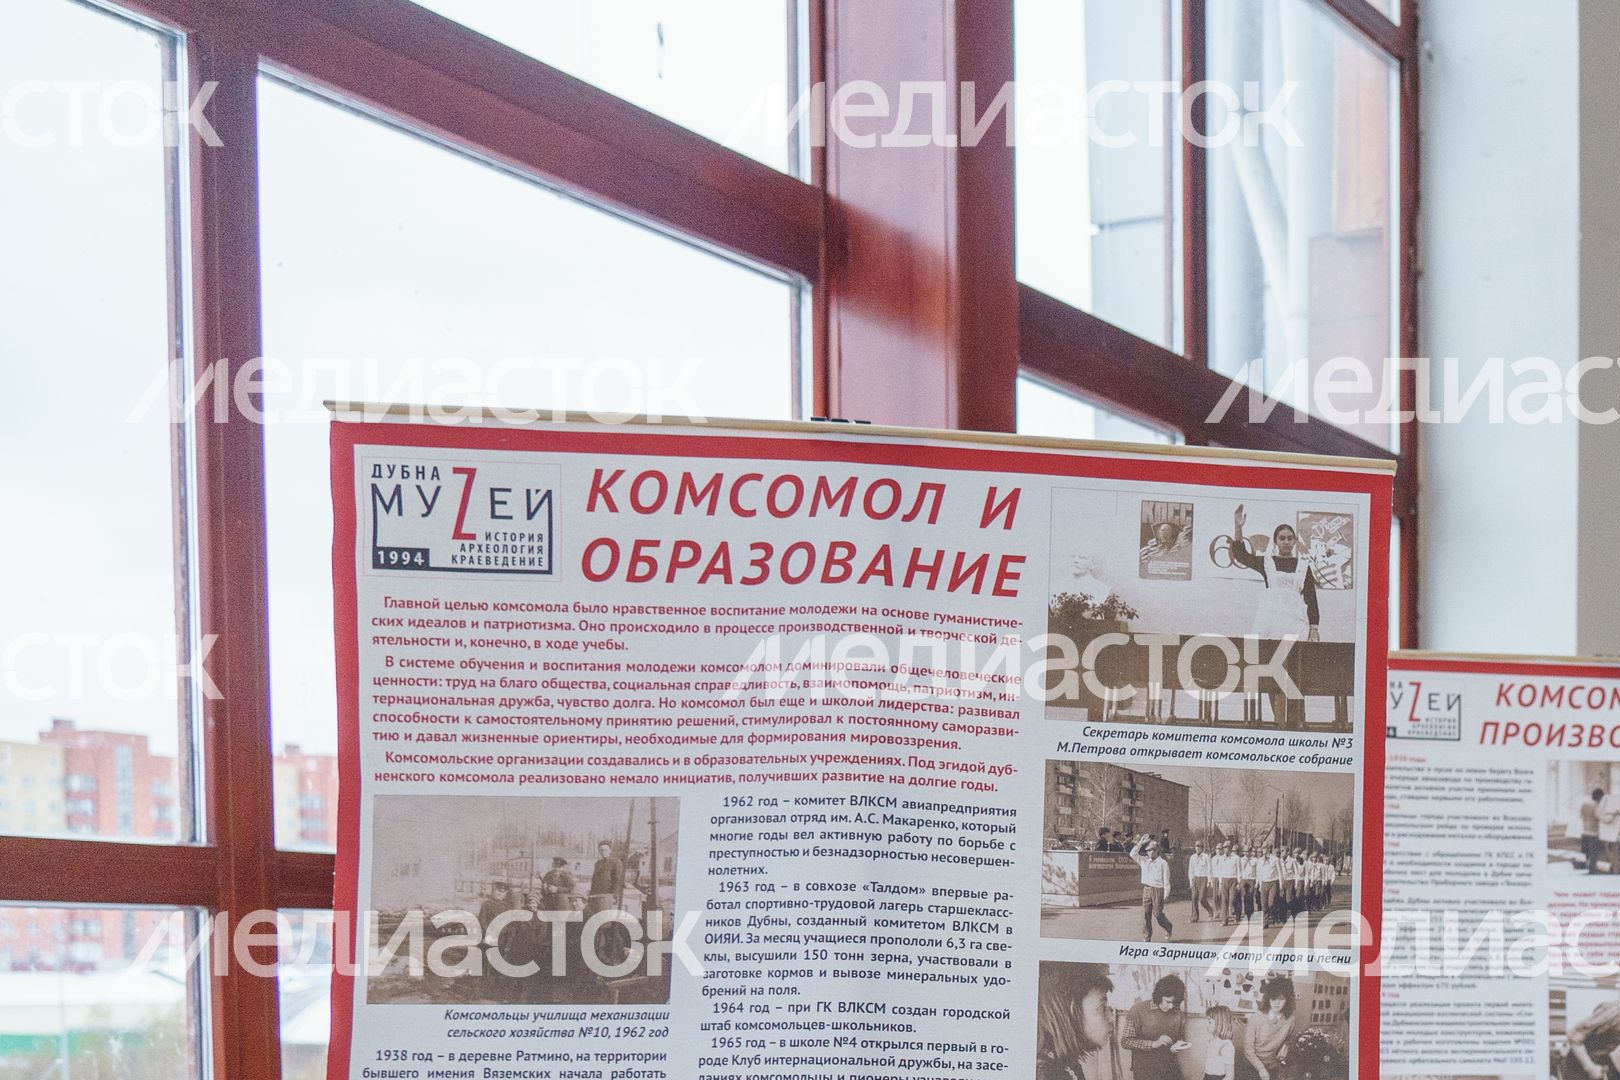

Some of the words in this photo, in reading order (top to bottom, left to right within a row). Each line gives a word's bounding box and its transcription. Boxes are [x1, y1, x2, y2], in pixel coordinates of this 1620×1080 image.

[371, 463, 441, 482] ДУБНА
[586, 469, 946, 525] КОМСОМОЛ
[979, 486, 1021, 530] И
[485, 531, 543, 543] ИСТОРИЯ
[377, 550, 425, 566] 1994
[459, 543, 543, 555] АРХЕОЛОГИЯ
[451, 554, 543, 567] КРАЕВЕДЕНИЕ
[581, 537, 1027, 598] ОБРАЗОВАНИЕ
[384, 596, 440, 610] Главной
[444, 601, 489, 612] целью
[493, 602, 569, 613] комсомола
[573, 601, 609, 614] было
[612, 605, 707, 617] нравственное
[710, 606, 786, 616] воспитание
[789, 605, 857, 615] молодежи
[861, 606, 878, 616] на
[881, 608, 930, 621] основе
[933, 613, 1023, 629] гуманистиче-
[1082, 726, 1149, 742] Секретарь
[1151, 732, 1217, 743] комитета
[1220, 735, 1285, 746] комсомола
[1288, 738, 1328, 748] школы
[1331, 737, 1354, 749] №3
[1056, 741, 1127, 757] М.Петрова
[1129, 747, 1203, 760] открывает
[1205, 751, 1296, 763] комсомольское
[1298, 753, 1353, 767] собрание
[709, 832, 754, 842] многие
[758, 832, 788, 842] годы
[793, 831, 815, 840] вел
[819, 831, 883, 844] активную
[888, 832, 933, 847] работу
[937, 837, 953, 846] по
[958, 836, 1005, 851] борьбе
[1009, 842, 1016, 851] с
[703, 953, 730, 963] клы,
[735, 952, 797, 964] высушили
[804, 949, 828, 961] 150
[833, 952, 864, 961] тонн
[870, 953, 913, 965] зерна,
[917, 955, 998, 968] участвовали
[1004, 960, 1012, 969] в
[1119, 945, 1149, 959] Игра
[1152, 947, 1219, 961] «Зарница»,
[1307, 954, 1314, 963] и
[444, 1009, 530, 1022] Комсомольцы
[532, 1012, 587, 1023] училища
[590, 1012, 670, 1022] механизации
[447, 1029, 507, 1038] сельского
[508, 1027, 575, 1038] хозяйства
[578, 1026, 611, 1040] №10,
[614, 1026, 646, 1038] 1962
[648, 1026, 669, 1038] год
